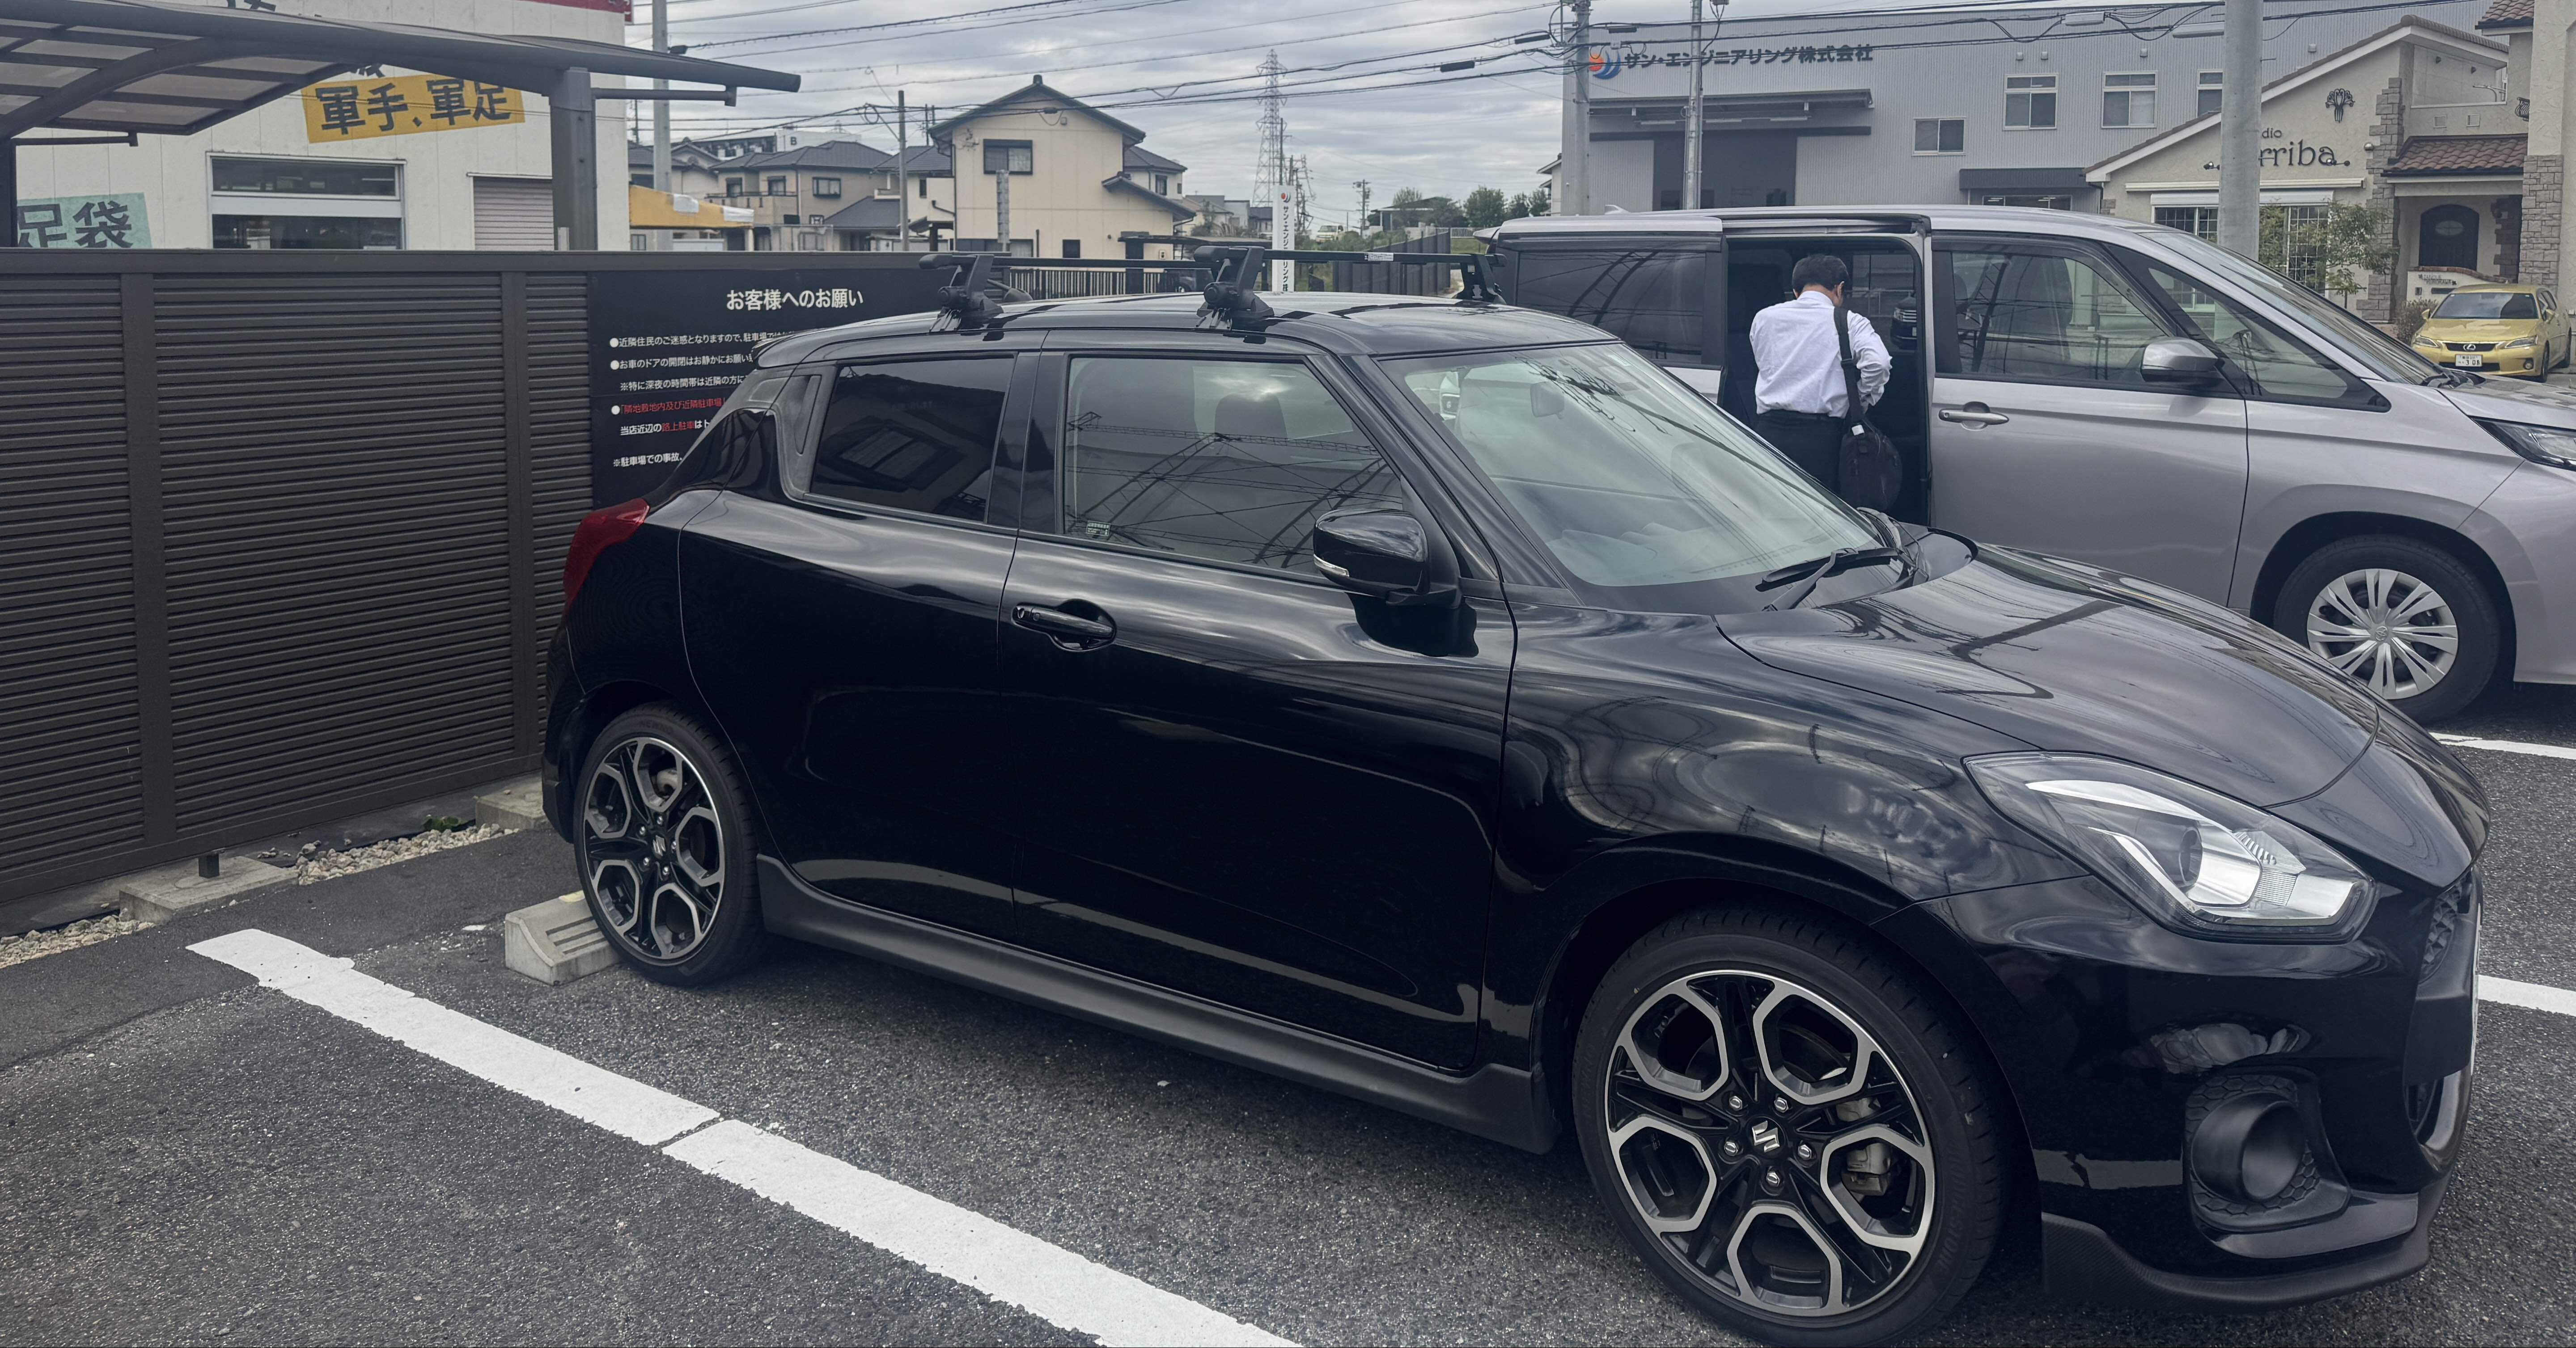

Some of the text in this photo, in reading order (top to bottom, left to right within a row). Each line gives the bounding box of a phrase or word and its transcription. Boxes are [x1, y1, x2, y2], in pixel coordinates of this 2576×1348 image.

[1624, 44, 1873, 68] サン・エンジニアリング株式会社
[791, 137, 797, 145] B
[2262, 128, 2282, 139] dio
[2260, 139, 2336, 167] rriba
[727, 288, 863, 311] お客様へのお願い
[620, 375, 748, 391] ※特に深夜の時間帯は近隣の方に
